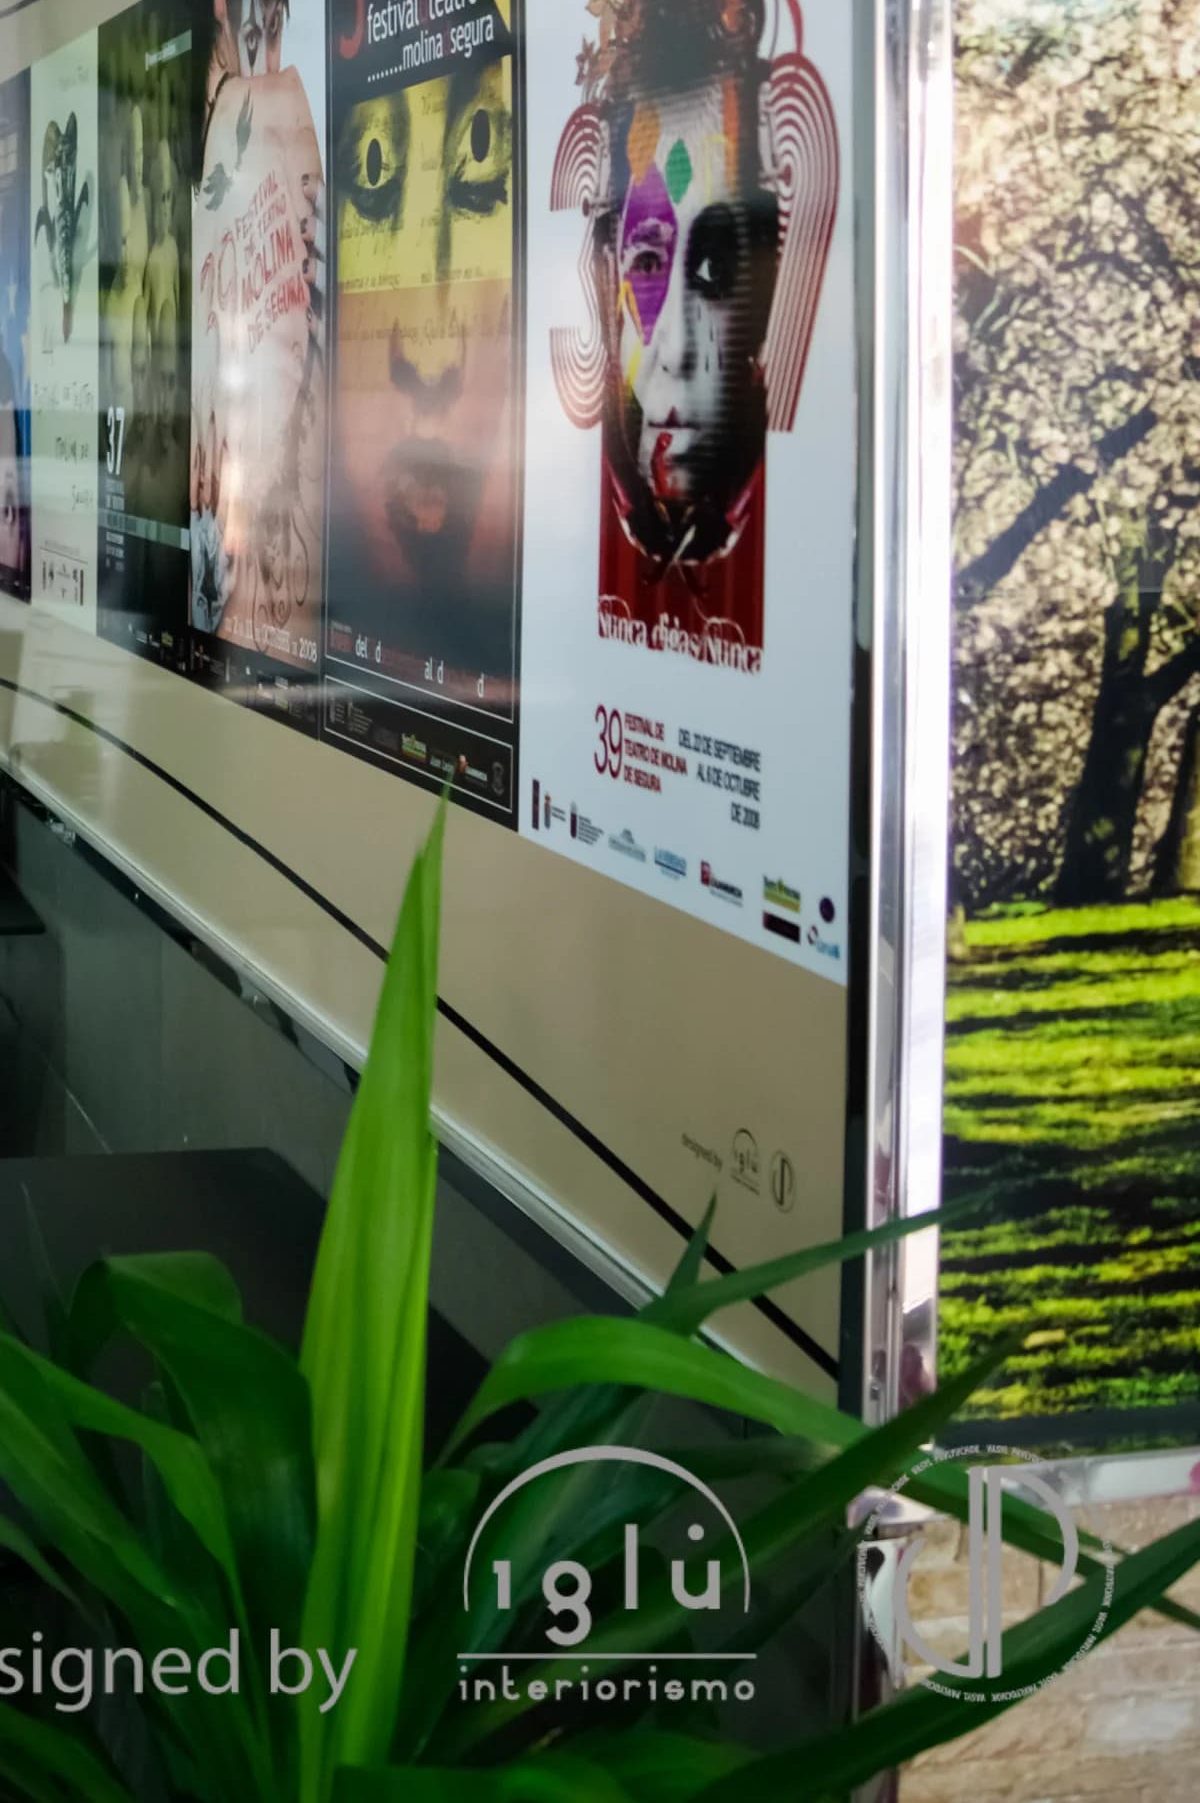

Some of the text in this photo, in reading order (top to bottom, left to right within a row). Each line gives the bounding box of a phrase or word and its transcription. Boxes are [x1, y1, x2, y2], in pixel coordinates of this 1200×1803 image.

[450, 14, 494, 58] segura
[241, 218, 296, 314] MOLINA
[106, 405, 125, 476] 37
[594, 704, 623, 779] 39
[624, 738, 688, 776] TEATRO DE MOLINA
[624, 764, 633, 784] DE
[731, 801, 741, 824] DE
